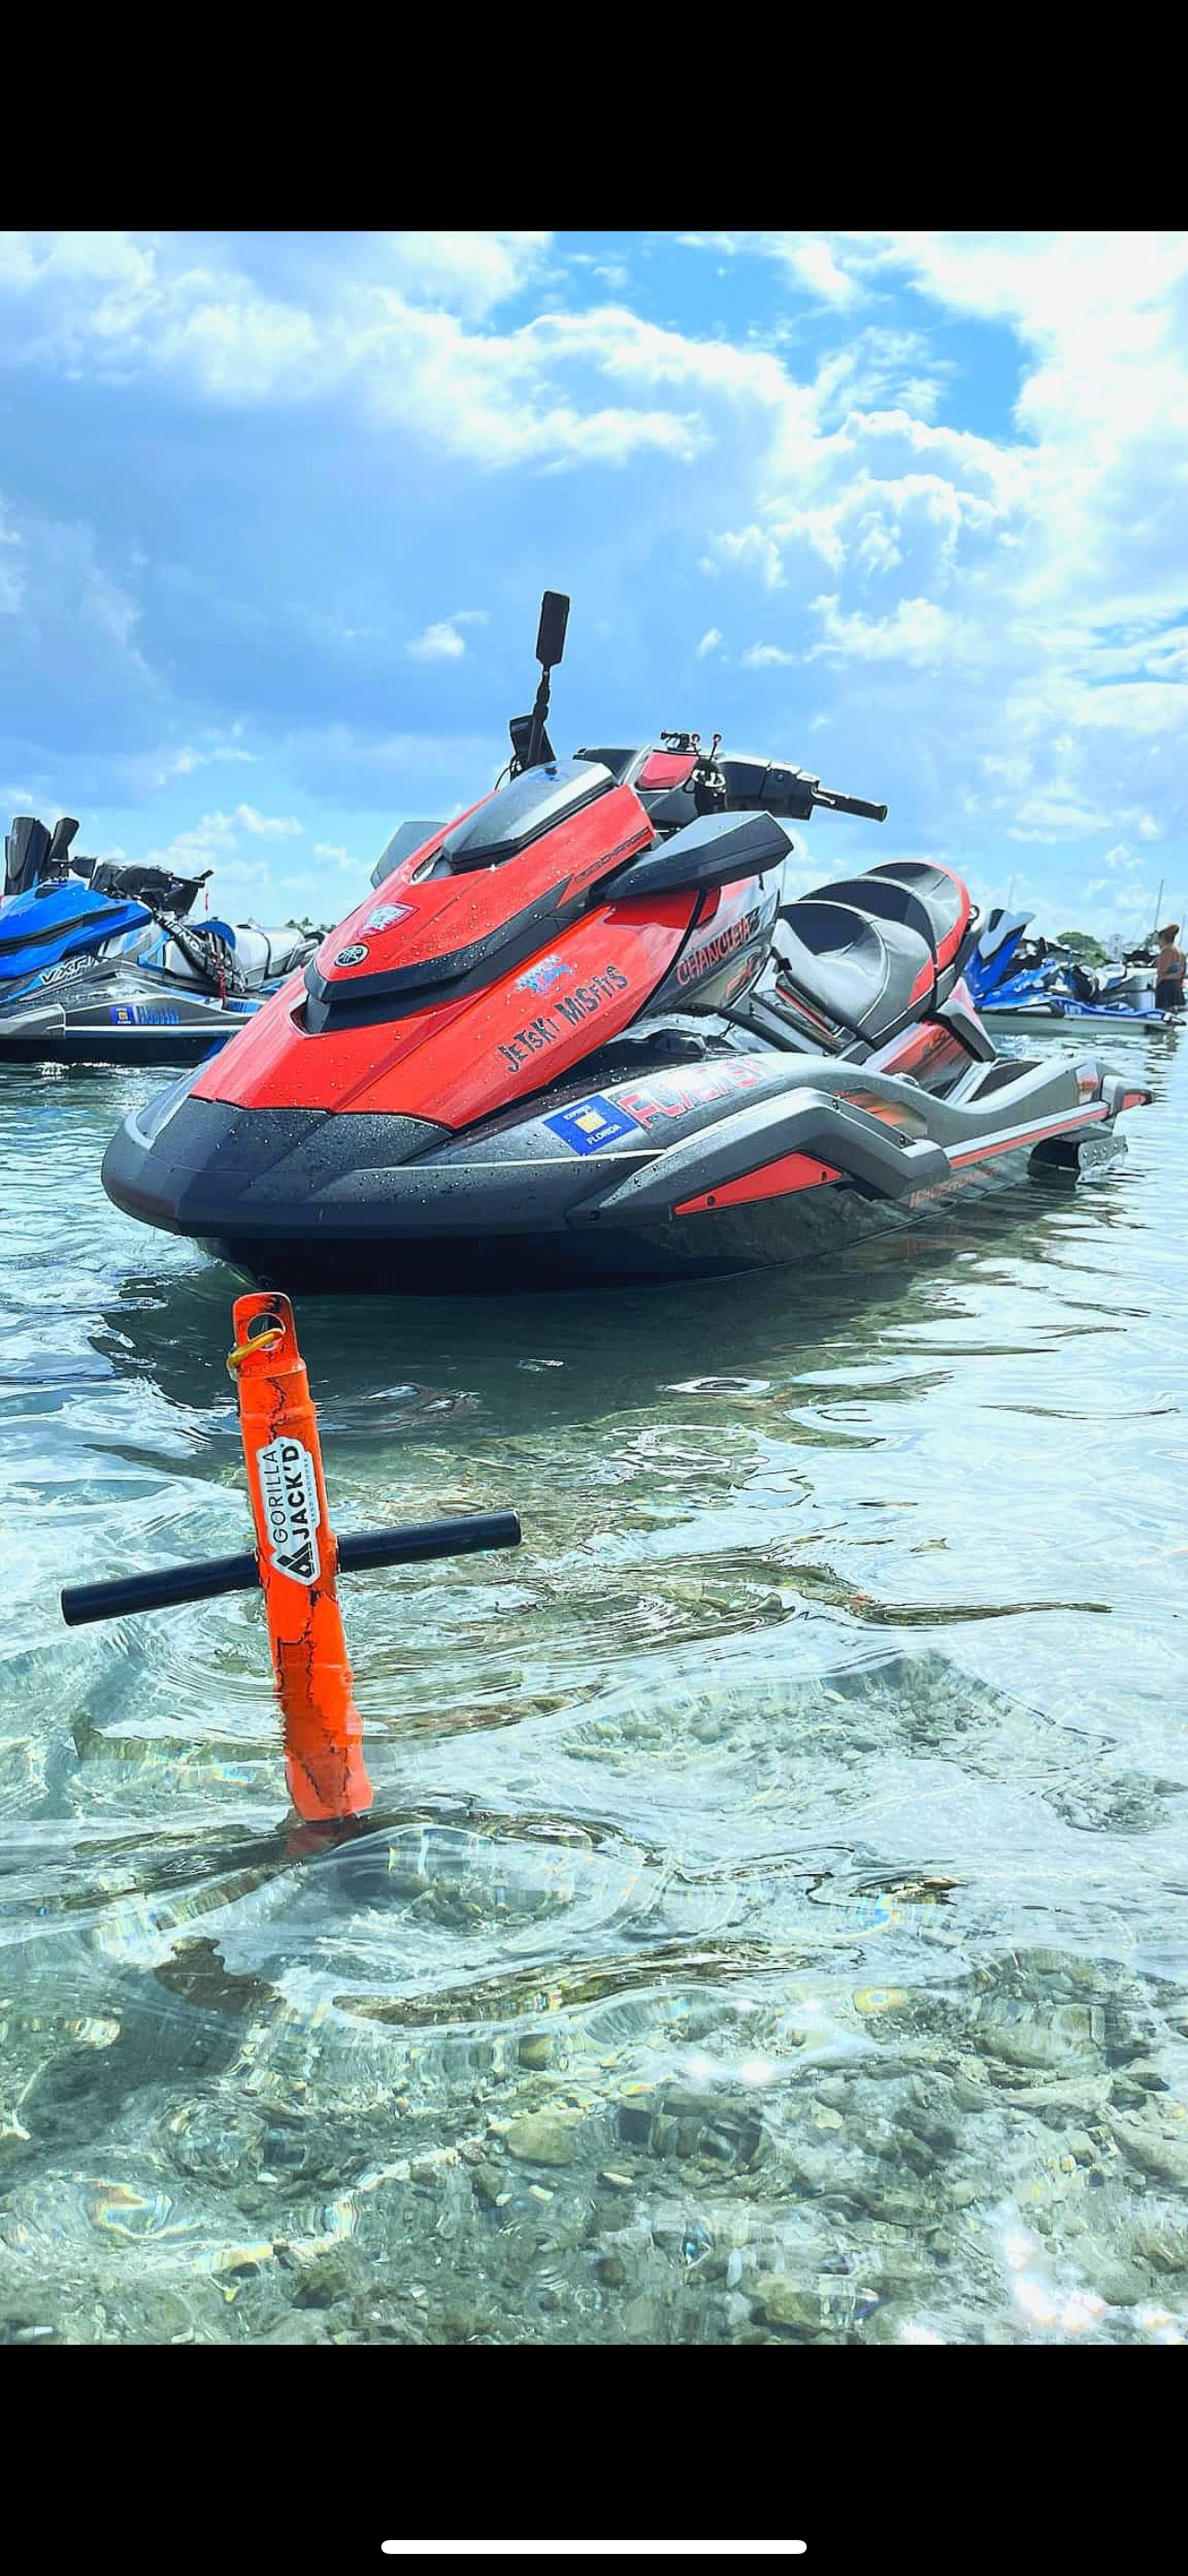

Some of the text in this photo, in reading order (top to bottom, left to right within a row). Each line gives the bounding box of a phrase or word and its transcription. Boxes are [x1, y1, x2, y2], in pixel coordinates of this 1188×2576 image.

[497, 1017, 560, 1072] JETSKI
[554, 966, 628, 1025] MISFITS
[586, 1124, 623, 1145] FLORIDA
[262, 1450, 288, 1543] GORILLA
[282, 1446, 309, 1540] JACK'D
